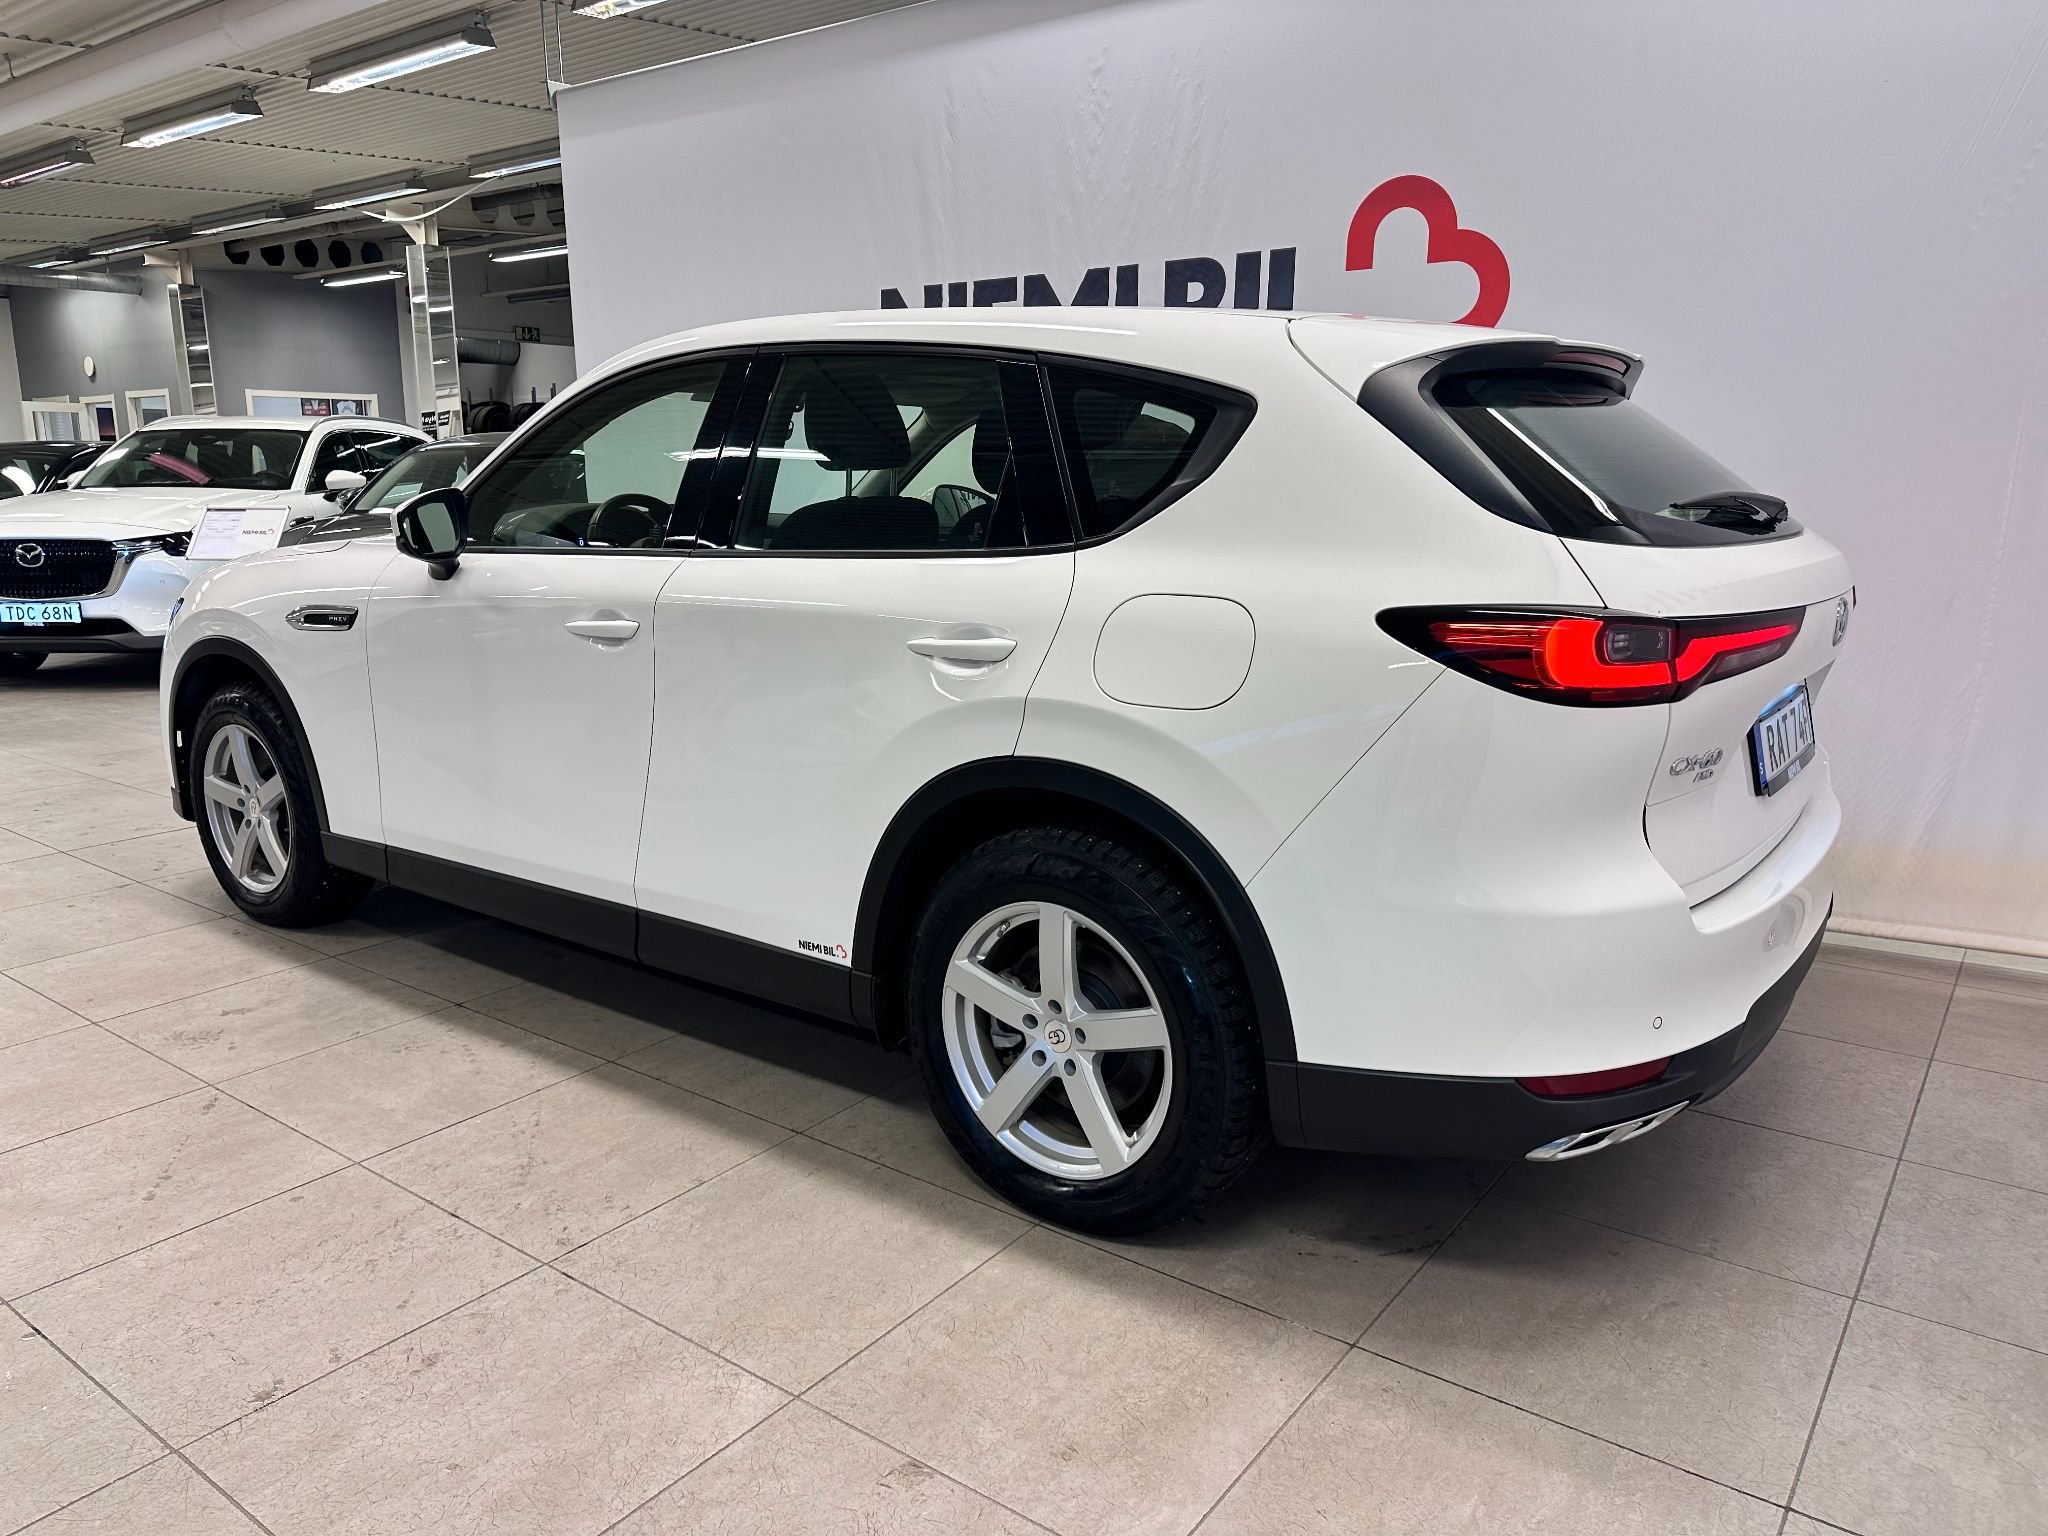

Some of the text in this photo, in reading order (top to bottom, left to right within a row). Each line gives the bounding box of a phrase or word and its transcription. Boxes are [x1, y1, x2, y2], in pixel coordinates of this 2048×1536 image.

[6, 606, 72, 620] TDC 68N
[1766, 713, 1790, 772] RAT
[1670, 748, 1723, 776] CX-60
[798, 939, 822, 954] NIEMI
